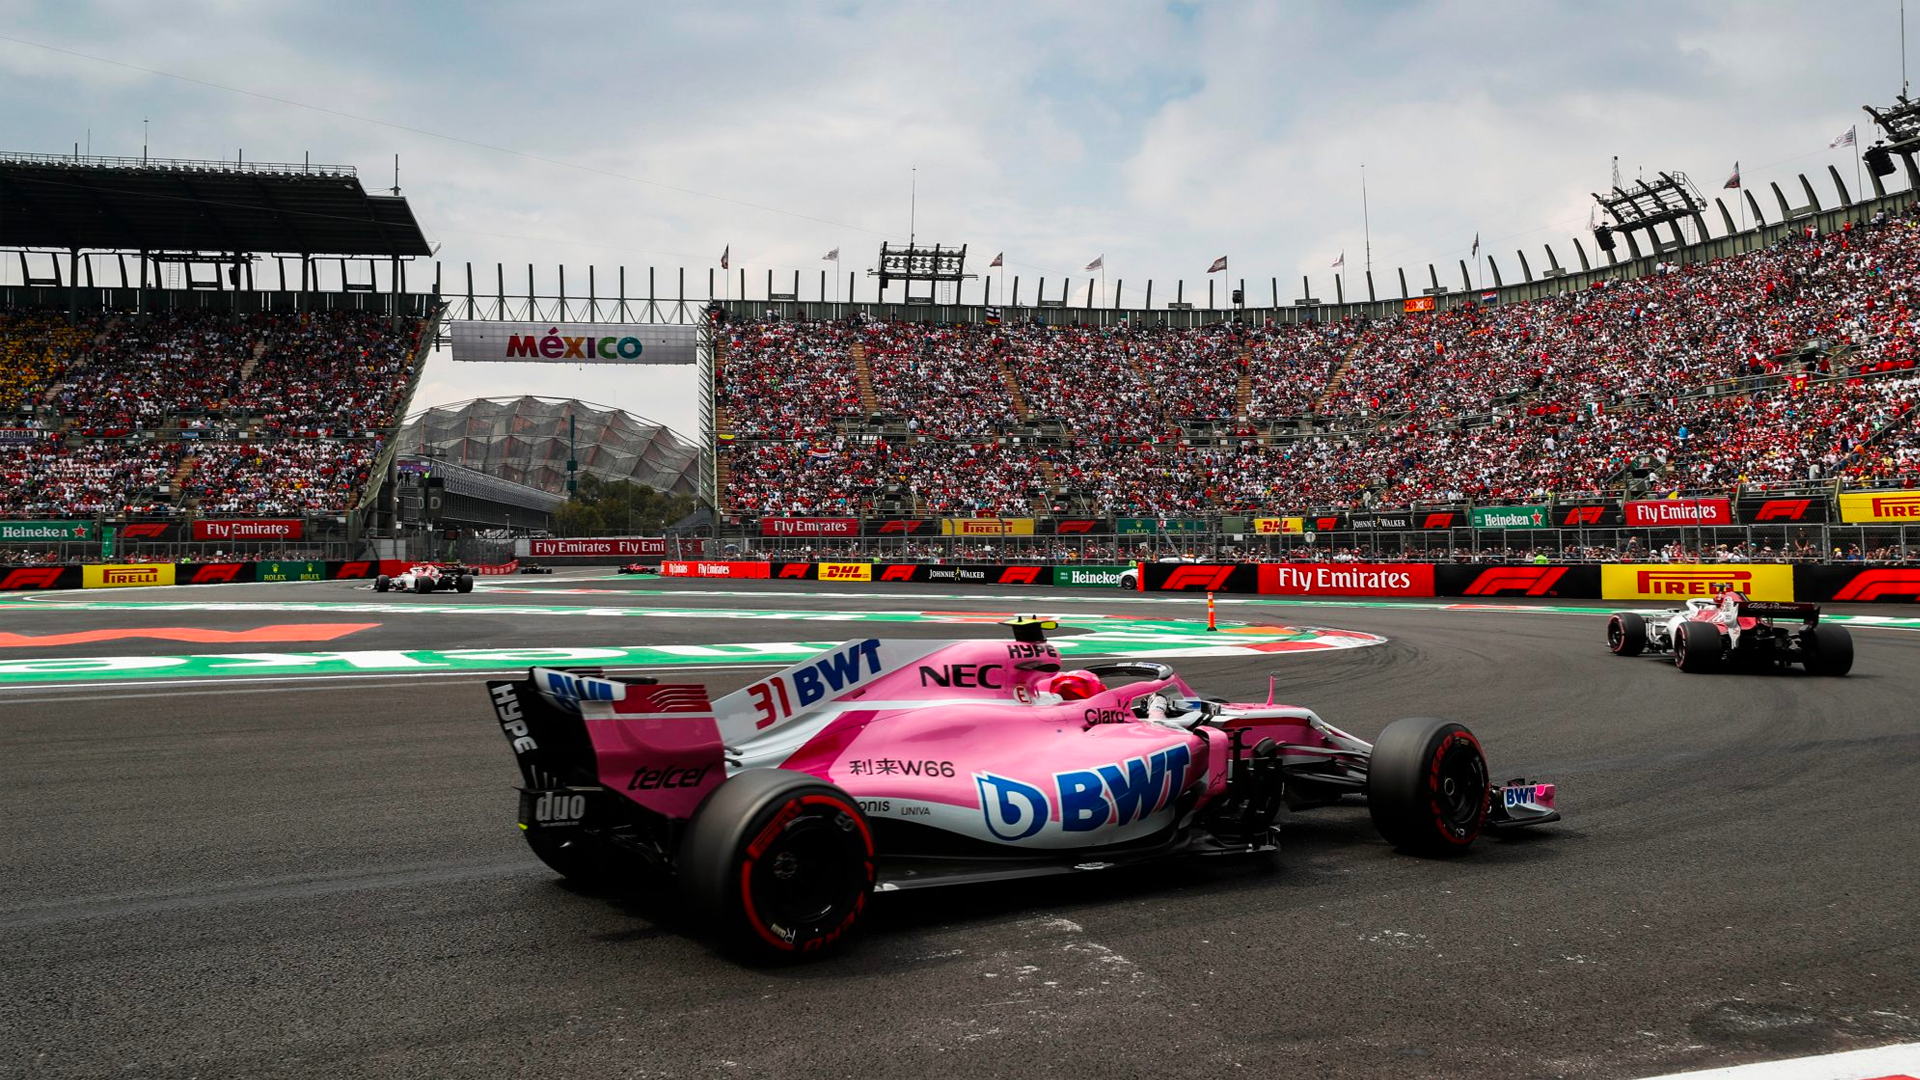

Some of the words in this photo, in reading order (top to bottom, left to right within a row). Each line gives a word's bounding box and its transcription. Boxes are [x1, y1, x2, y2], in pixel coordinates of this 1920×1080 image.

[1484, 513, 1530, 527] Heineken
[1637, 505, 1658, 523] Fly
[1660, 503, 1717, 520] Emirates
[2, 526, 69, 538] Heineken
[206, 523, 229, 537] Fly
[232, 523, 290, 535] Emirates
[963, 521, 1014, 533] PIRELLI
[1262, 520, 1292, 533] DHL
[1352, 519, 1377, 530] JOHNNE
[1380, 518, 1406, 528] WALKER
[535, 541, 556, 555] Fly
[558, 540, 611, 553] Emirates
[619, 541, 639, 554] Fly
[103, 568, 158, 584] PIRELLI
[707, 563, 730, 574] Emirates
[826, 565, 863, 579] DHL
[929, 569, 955, 579] JOHNNIE
[960, 569, 985, 579] WALKER
[1278, 567, 1312, 592] Fly
[1316, 567, 1411, 589] Emirates
[1006, 642, 1059, 659] HYPE
[746, 676, 793, 731] 31
[792, 637, 882, 707] BWT
[919, 663, 1003, 690] NEC
[491, 683, 539, 754] HYPE
[627, 763, 714, 792] telcel
[1053, 741, 1194, 833] BWT
[1506, 786, 1537, 805] BWT
[535, 791, 586, 821] duo
